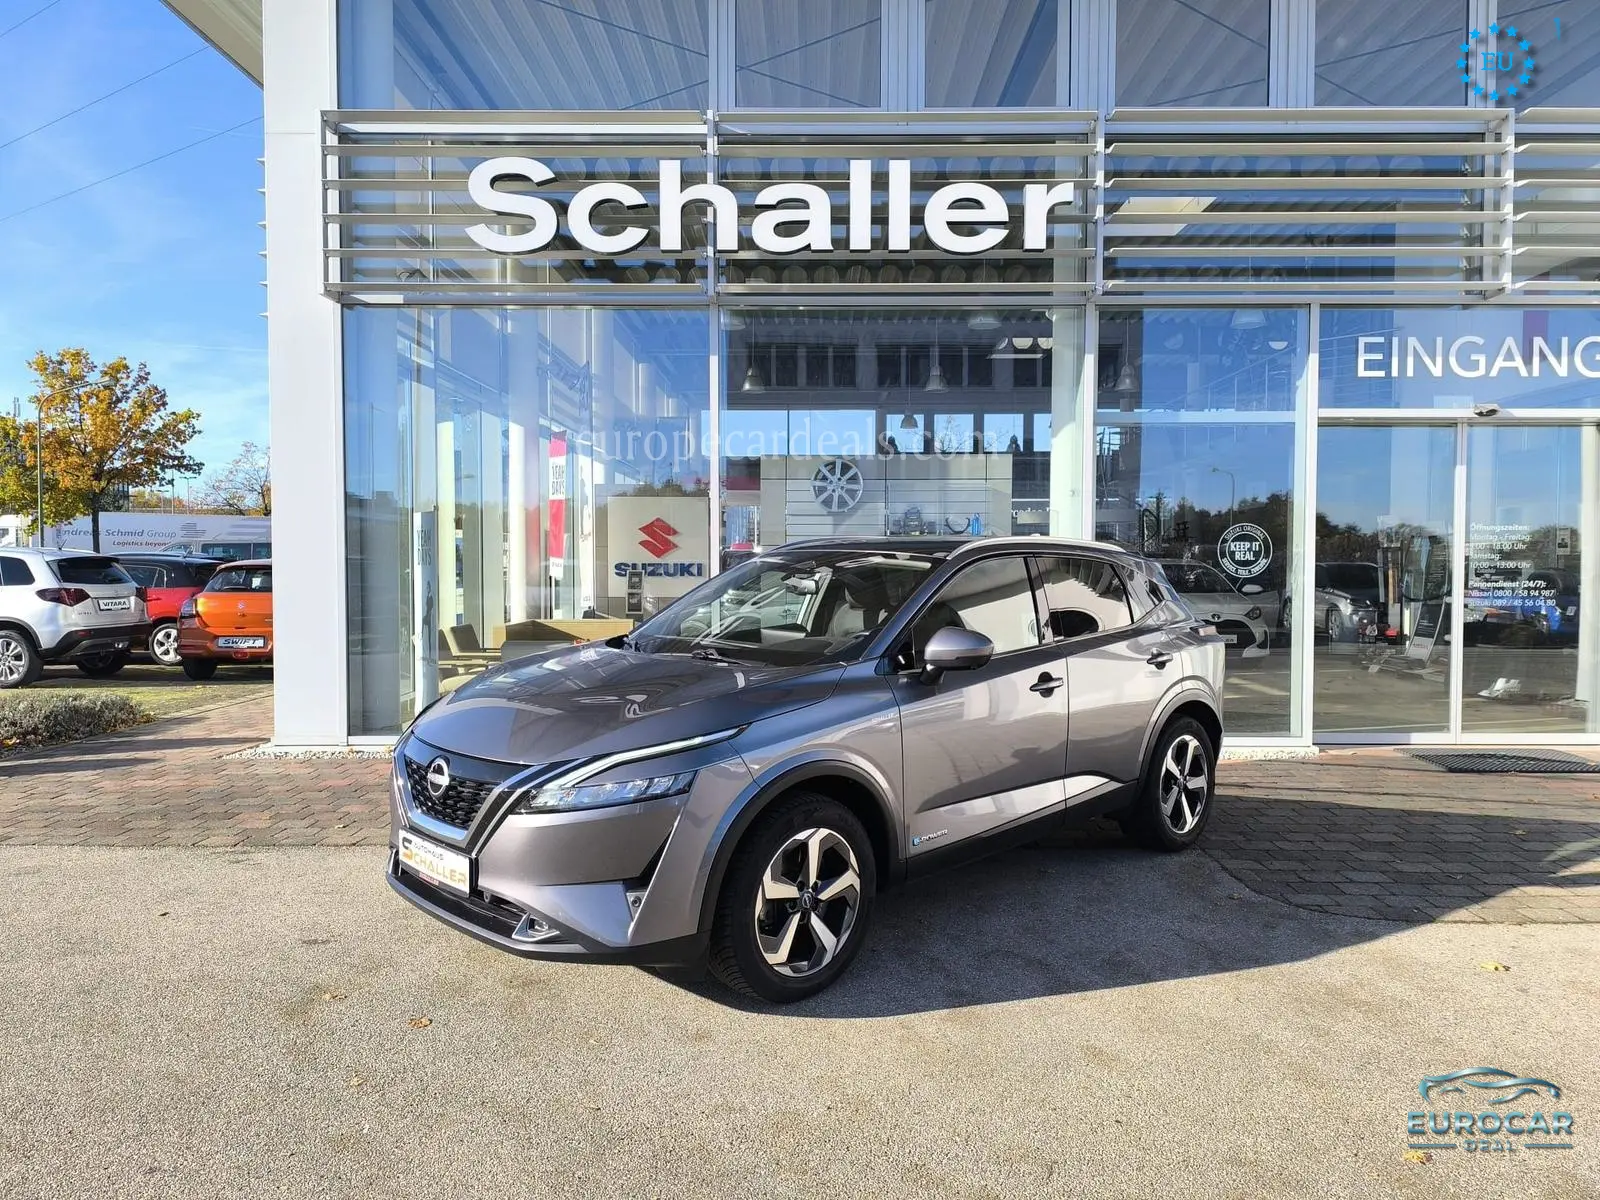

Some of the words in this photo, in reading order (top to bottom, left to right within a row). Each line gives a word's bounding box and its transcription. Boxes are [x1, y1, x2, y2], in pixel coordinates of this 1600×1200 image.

[464, 156, 1074, 255] Schaller
[1357, 335, 1600, 378] EINGANG
[105, 529, 144, 537] Schmid
[146, 530, 177, 539] Group
[1230, 541, 1250, 551] KEEP
[1252, 541, 1260, 551] IT
[1514, 542, 1527, 550] Uhr
[1235, 551, 1255, 560] REAL
[614, 562, 703, 577] SUZUKI
[1521, 580, 1547, 588] (24/7):
[1541, 589, 1555, 597] 987
